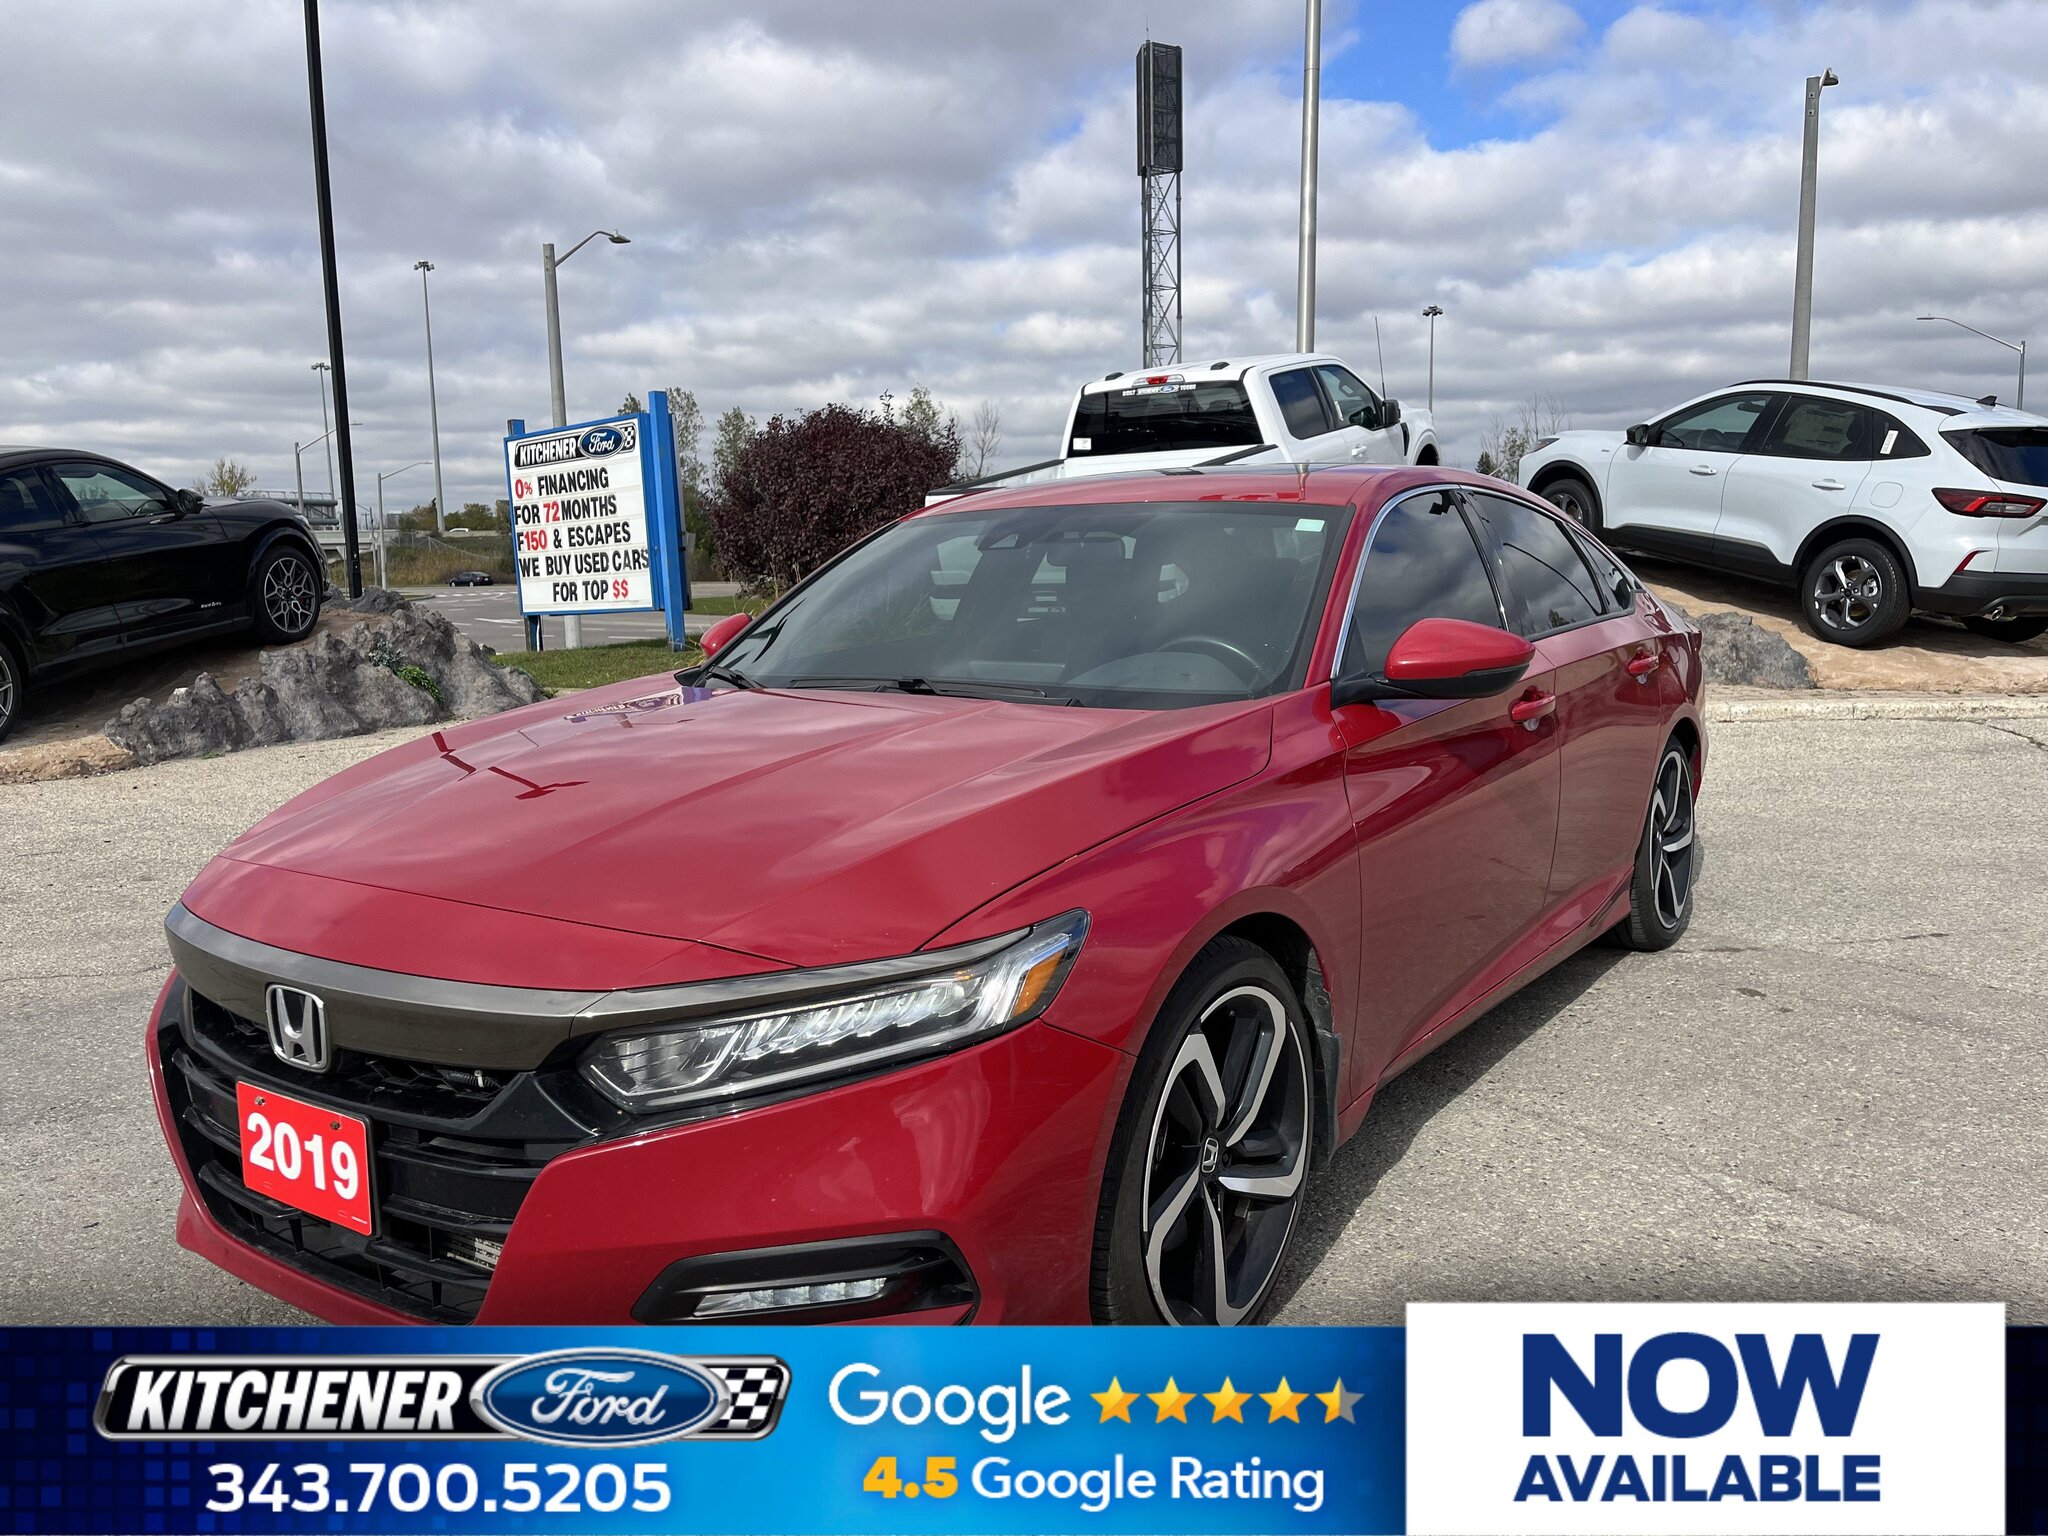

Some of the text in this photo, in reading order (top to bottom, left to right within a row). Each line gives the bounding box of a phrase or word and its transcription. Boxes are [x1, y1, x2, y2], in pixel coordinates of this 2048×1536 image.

[519, 431, 615, 467] KITCHENER Ford
[515, 466, 609, 499] 0% FINANCING
[514, 494, 617, 525] FOR 72 MONTHS
[516, 521, 631, 551] F150 & ESCAPES
[519, 548, 649, 577] WE BUY USED CARS
[552, 579, 629, 602] FOR TOP $$
[247, 1111, 359, 1200] 2019
